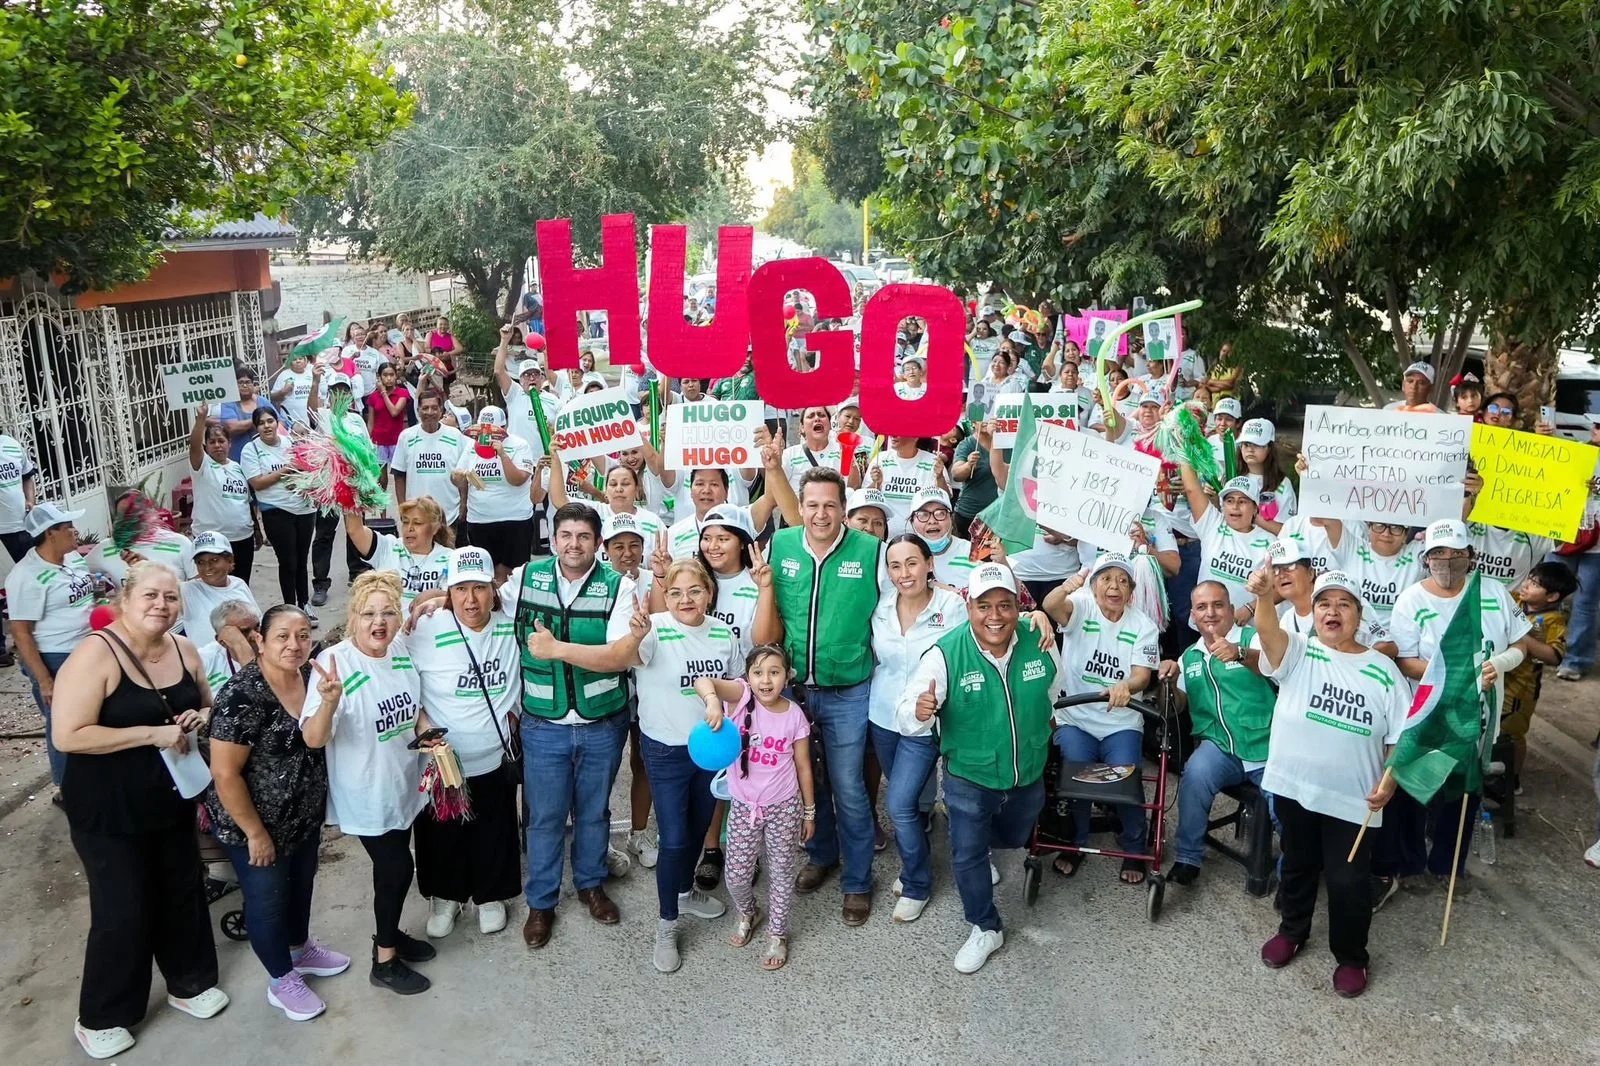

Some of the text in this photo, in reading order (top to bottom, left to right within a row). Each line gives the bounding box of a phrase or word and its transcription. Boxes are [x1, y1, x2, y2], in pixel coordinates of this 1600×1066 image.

[536, 213, 966, 438] HUGO
[163, 358, 233, 375] LA AMISTAD
[189, 374, 214, 385] CON
[182, 387, 226, 404] HUGO
[557, 414, 571, 432] EN
[573, 400, 630, 427] EQUIPO
[683, 404, 747, 423] HUGO
[996, 405, 1076, 418] #HGO SI
[557, 420, 636, 450] CON HUGO
[682, 425, 748, 444] HUGO
[1375, 422, 1427, 440] arriba
[1438, 430, 1465, 441] sin
[683, 447, 748, 466] HUGO
[1037, 425, 1153, 477] Hugo las secciones
[1503, 431, 1571, 463] AMISTAD
[0, 463, 15, 473] UGO
[1307, 464, 1455, 485] la AMISTAD viene
[1496, 454, 1545, 480] DAVILA
[891, 477, 917, 485] HUGO
[1320, 486, 1427, 517] a APOYAR
[1219, 551, 1253, 568] HUGO
[1477, 552, 1512, 567] HUGO
[407, 571, 439, 580] HGO
[686, 659, 724, 673] HUGO
[1025, 660, 1042, 669] HUGO
[378, 692, 412, 715] HUGO
[1322, 682, 1365, 708] HUGO
[1309, 694, 1373, 725] DÁVILA
